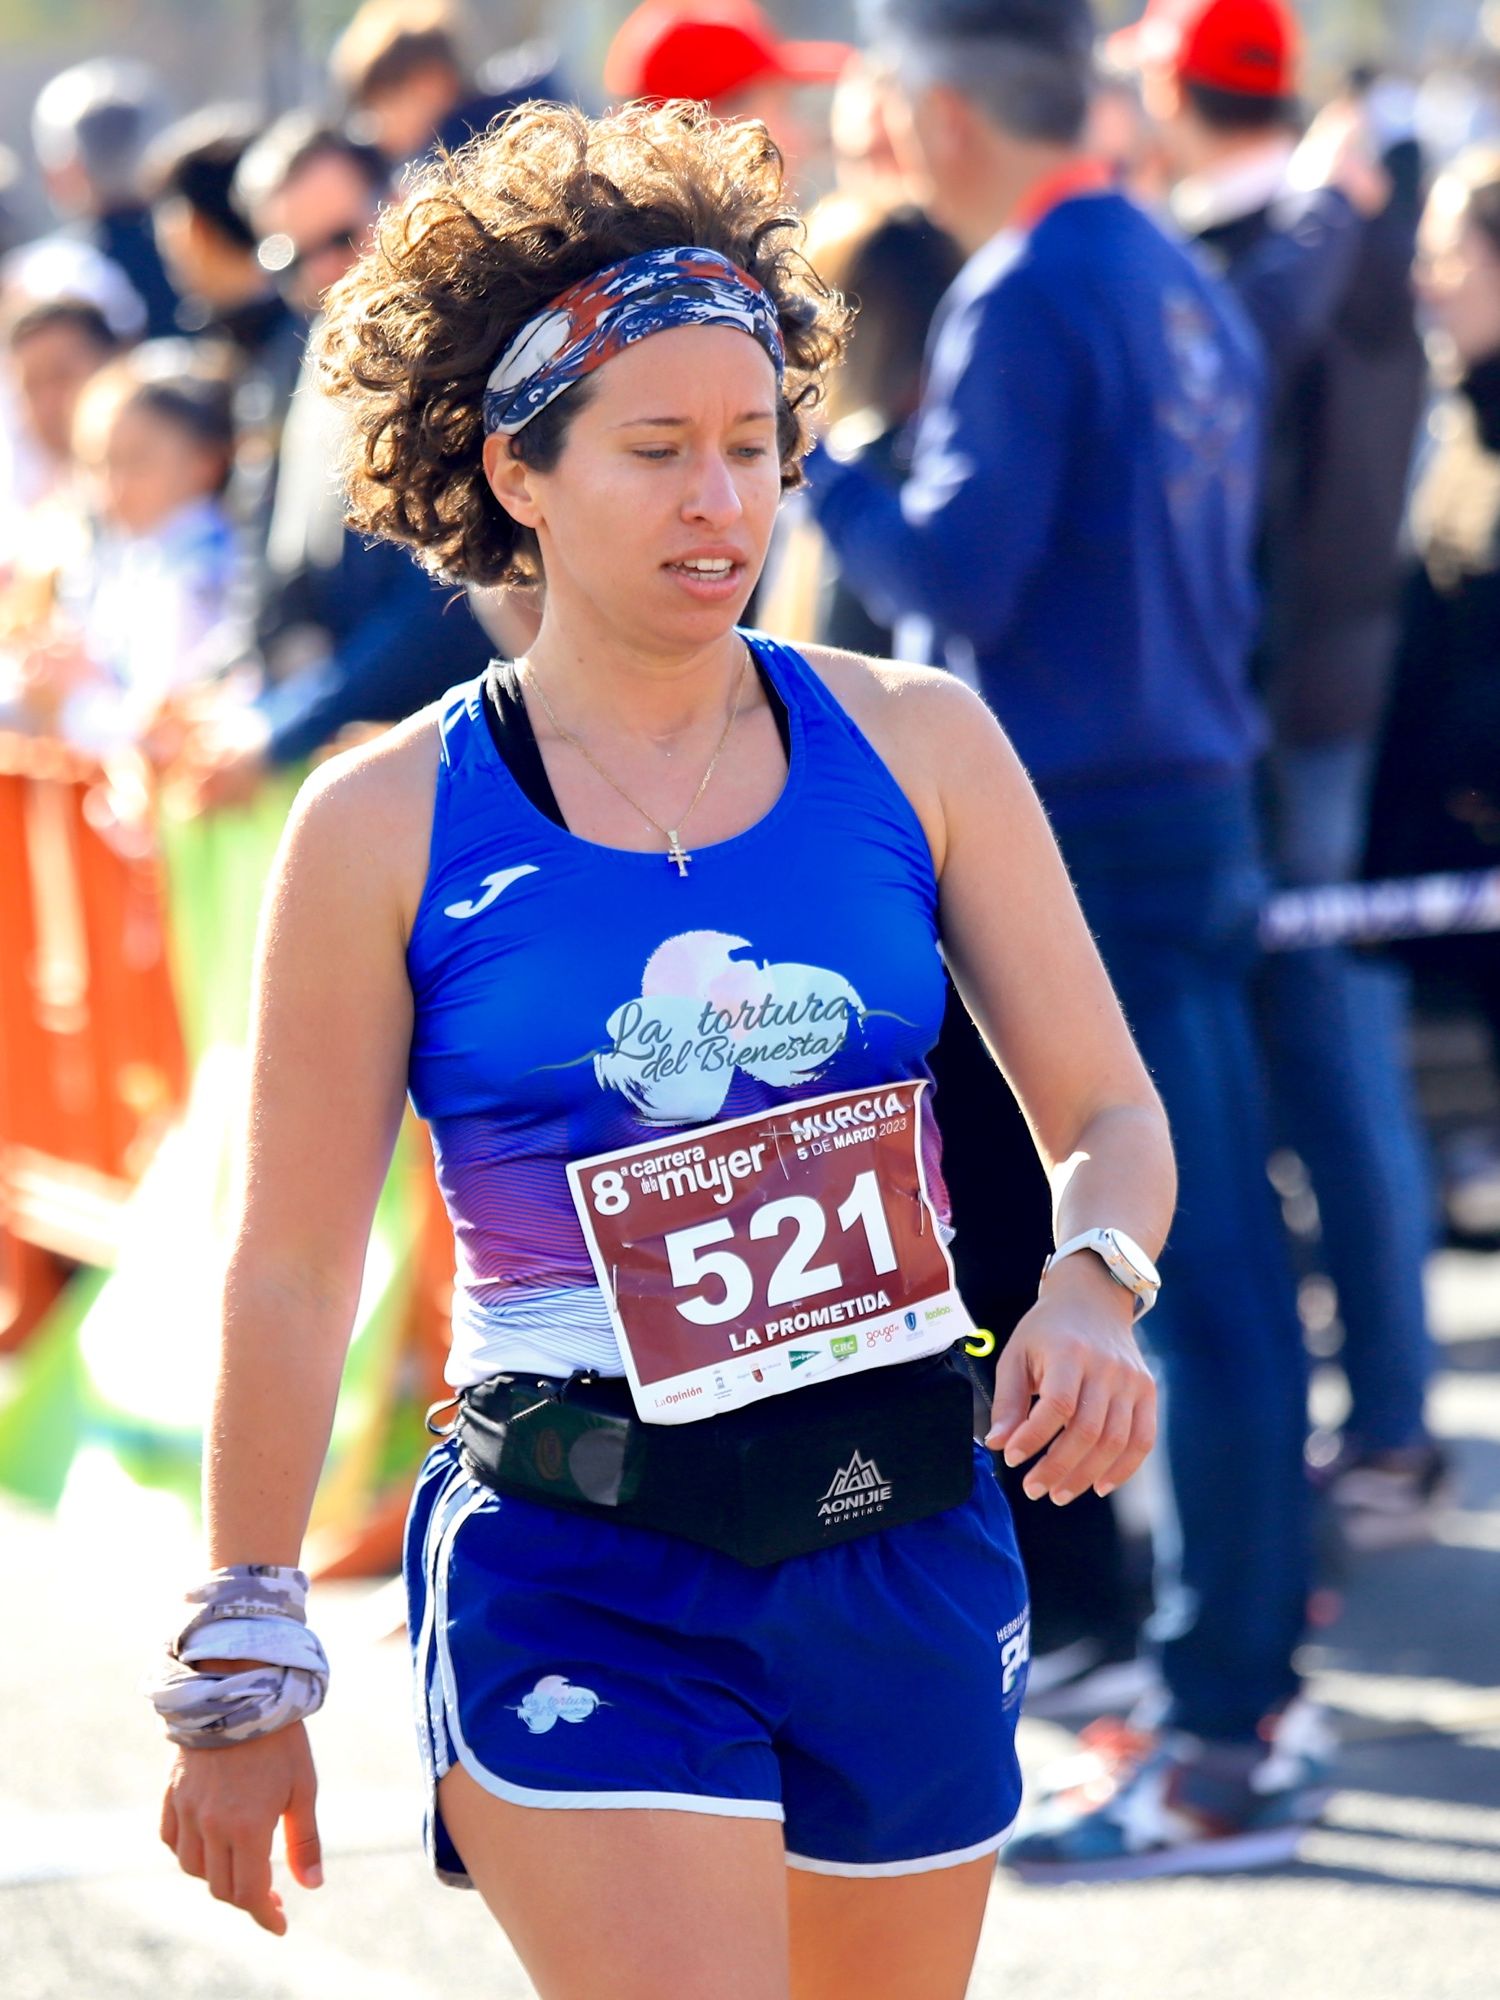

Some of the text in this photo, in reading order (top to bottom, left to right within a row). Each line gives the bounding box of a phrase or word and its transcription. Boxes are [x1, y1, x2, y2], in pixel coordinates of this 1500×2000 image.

[611, 993, 852, 1060] La tortura
[641, 1032, 849, 1083] del Bienestar
[790, 1093, 906, 1144] MURCIA
[797, 1118, 907, 1161] 5 DE MARZO 2023
[630, 1146, 706, 1178] carrera
[657, 1143, 766, 1205] mujer
[664, 1169, 898, 1326] 521
[729, 1290, 892, 1352] LA PROMETIDA
[817, 1486, 893, 1517] AONIJIE
[825, 1505, 883, 1526] RUNNING
